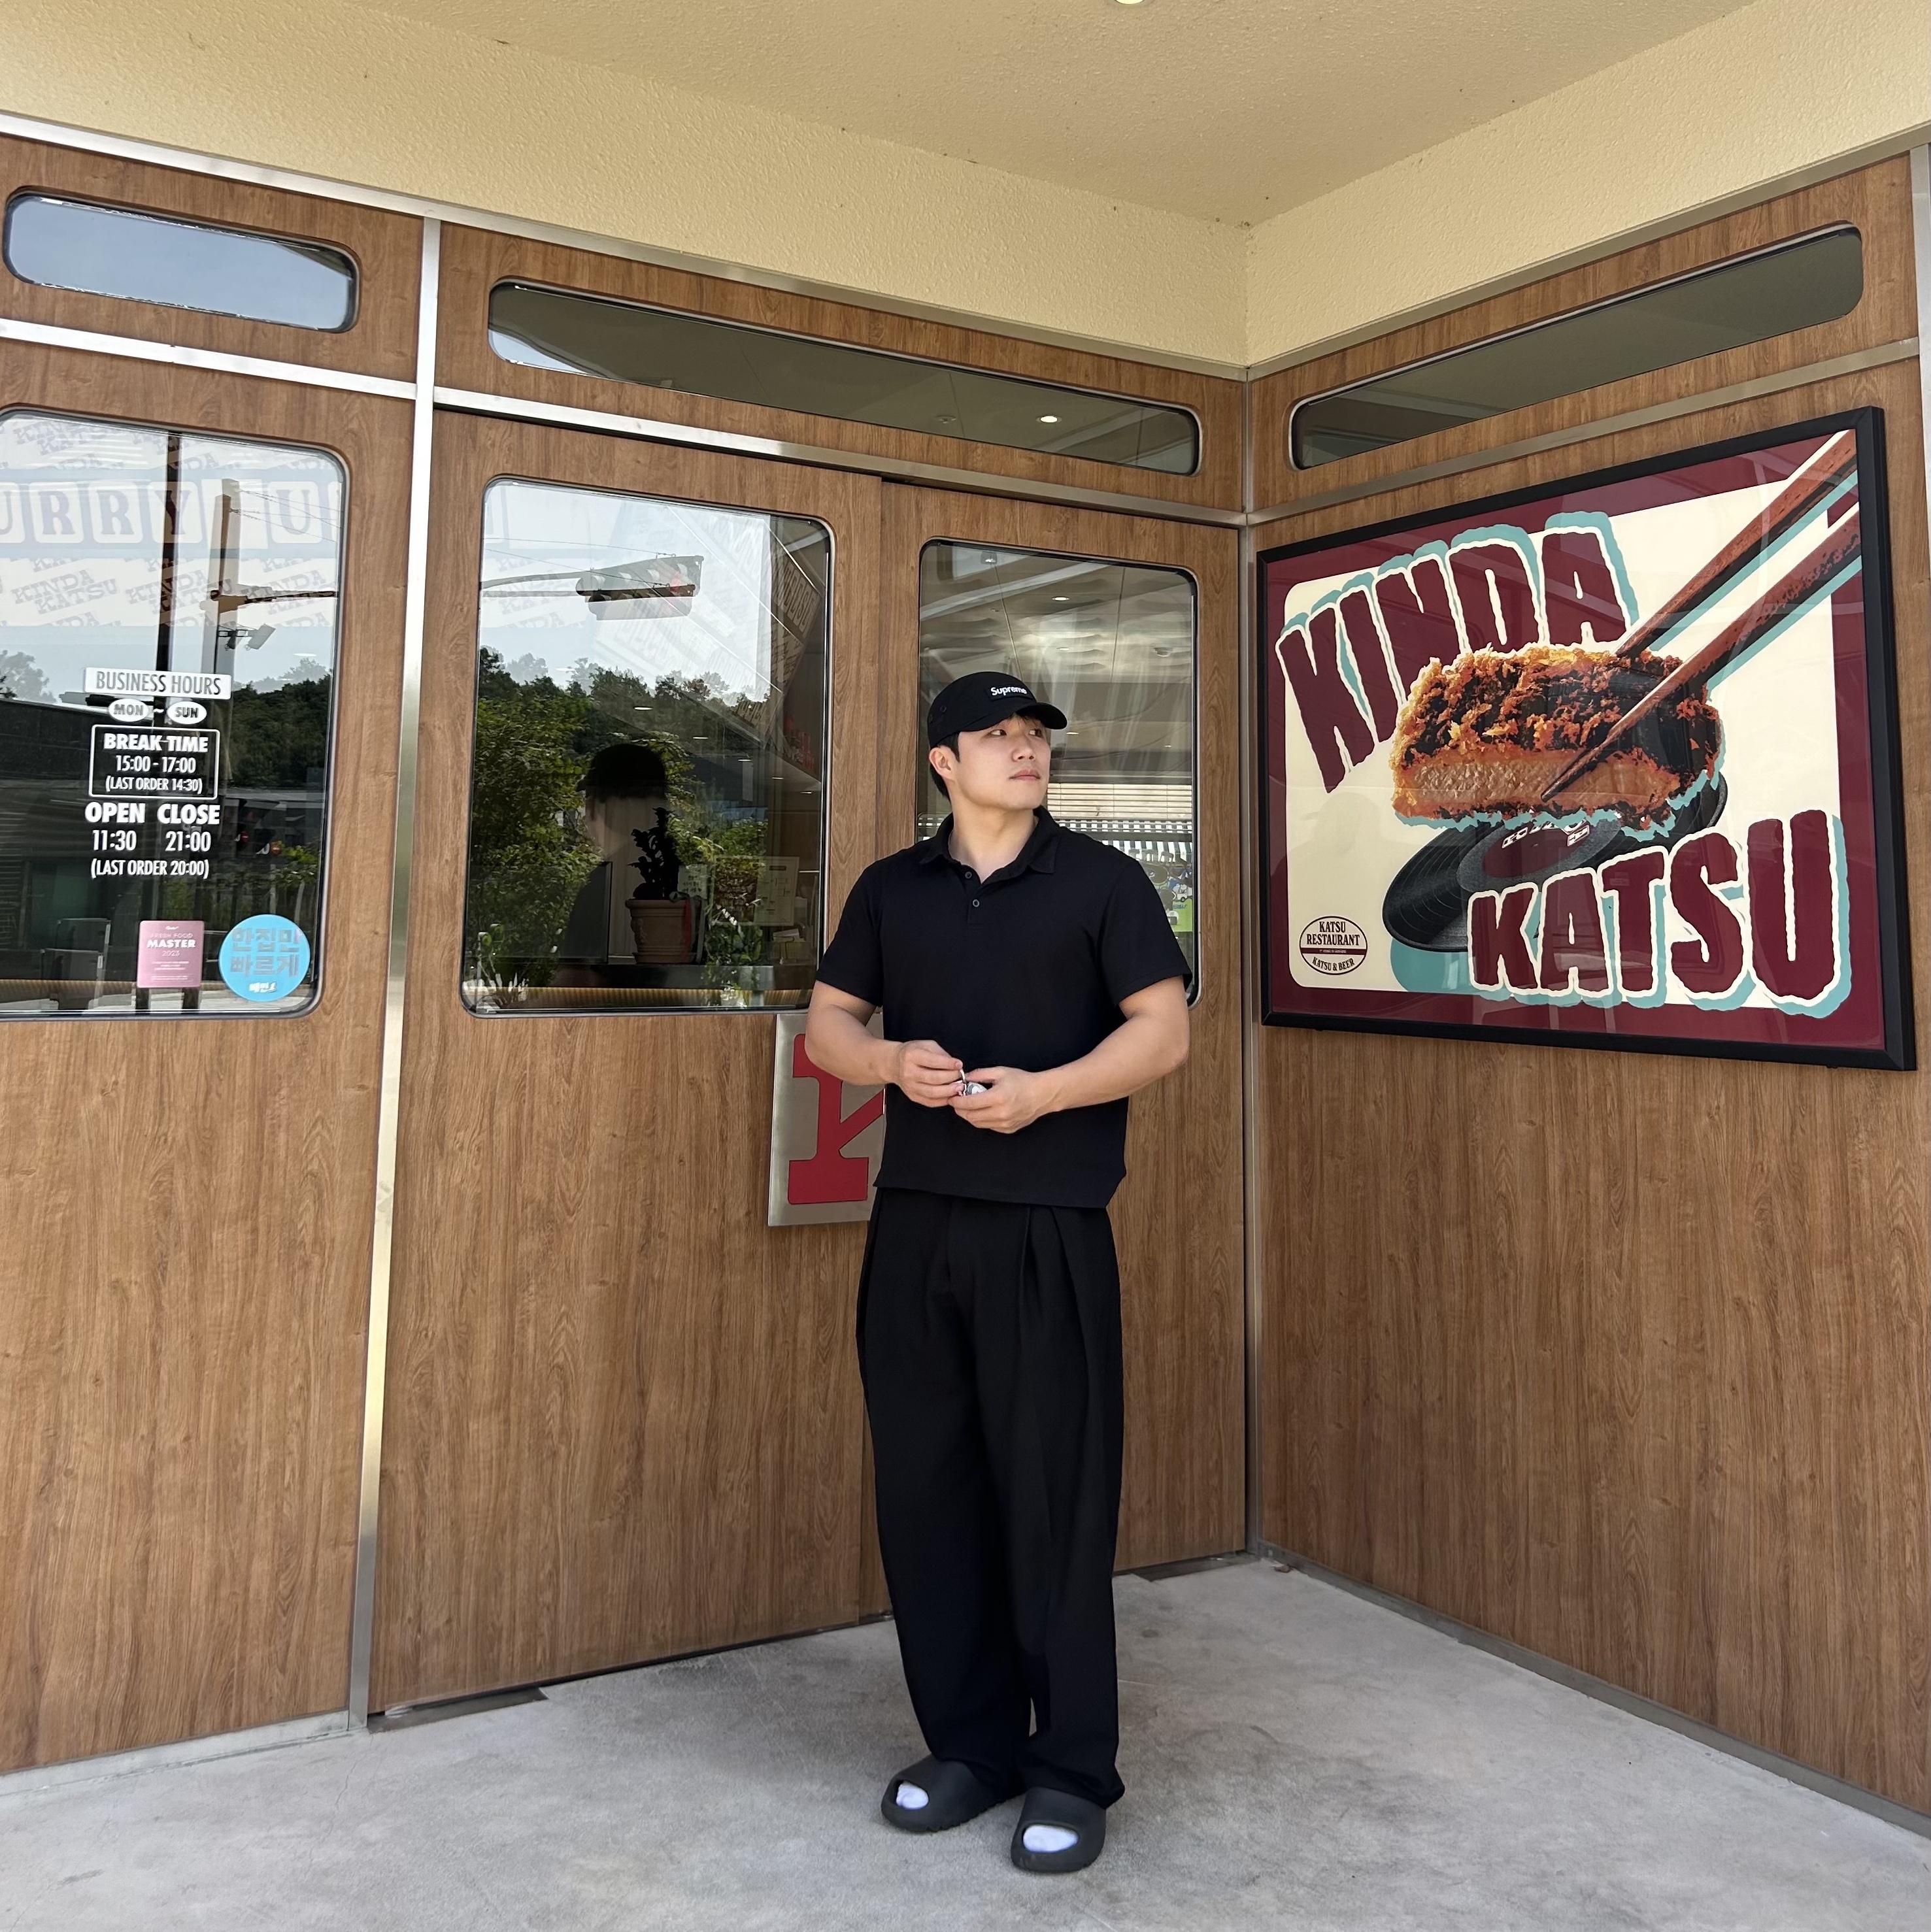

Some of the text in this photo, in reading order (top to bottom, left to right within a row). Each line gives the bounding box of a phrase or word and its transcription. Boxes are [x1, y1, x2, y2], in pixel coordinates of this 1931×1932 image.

[11, 569, 95, 604] KINDA
[34, 578, 118, 614] KATSU
[1276, 527, 1632, 793] KINDA
[97, 671, 221, 695] BUSINESS HOURS
[990, 686, 1027, 696] Supreme
[114, 703, 144, 716] MON
[175, 707, 199, 718] SUN
[104, 733, 209, 752] BREAK TIME
[116, 755, 150, 773] 15:00
[163, 756, 196, 773] 17:00
[105, 775, 203, 794] (LAST ORDER 14:30)
[85, 802, 220, 825] OPEN CLOSE
[92, 830, 211, 852] 11:30 21:00
[91, 858, 209, 880] (LAST ORDER 20:00)
[1469, 810, 1838, 1003] KATSU
[1319, 921, 1346, 933] KATSU
[146, 939, 196, 948] MASTER
[1307, 934, 1360, 946] RESTAURANT
[1312, 956, 1355, 971] KATSU & BEER
